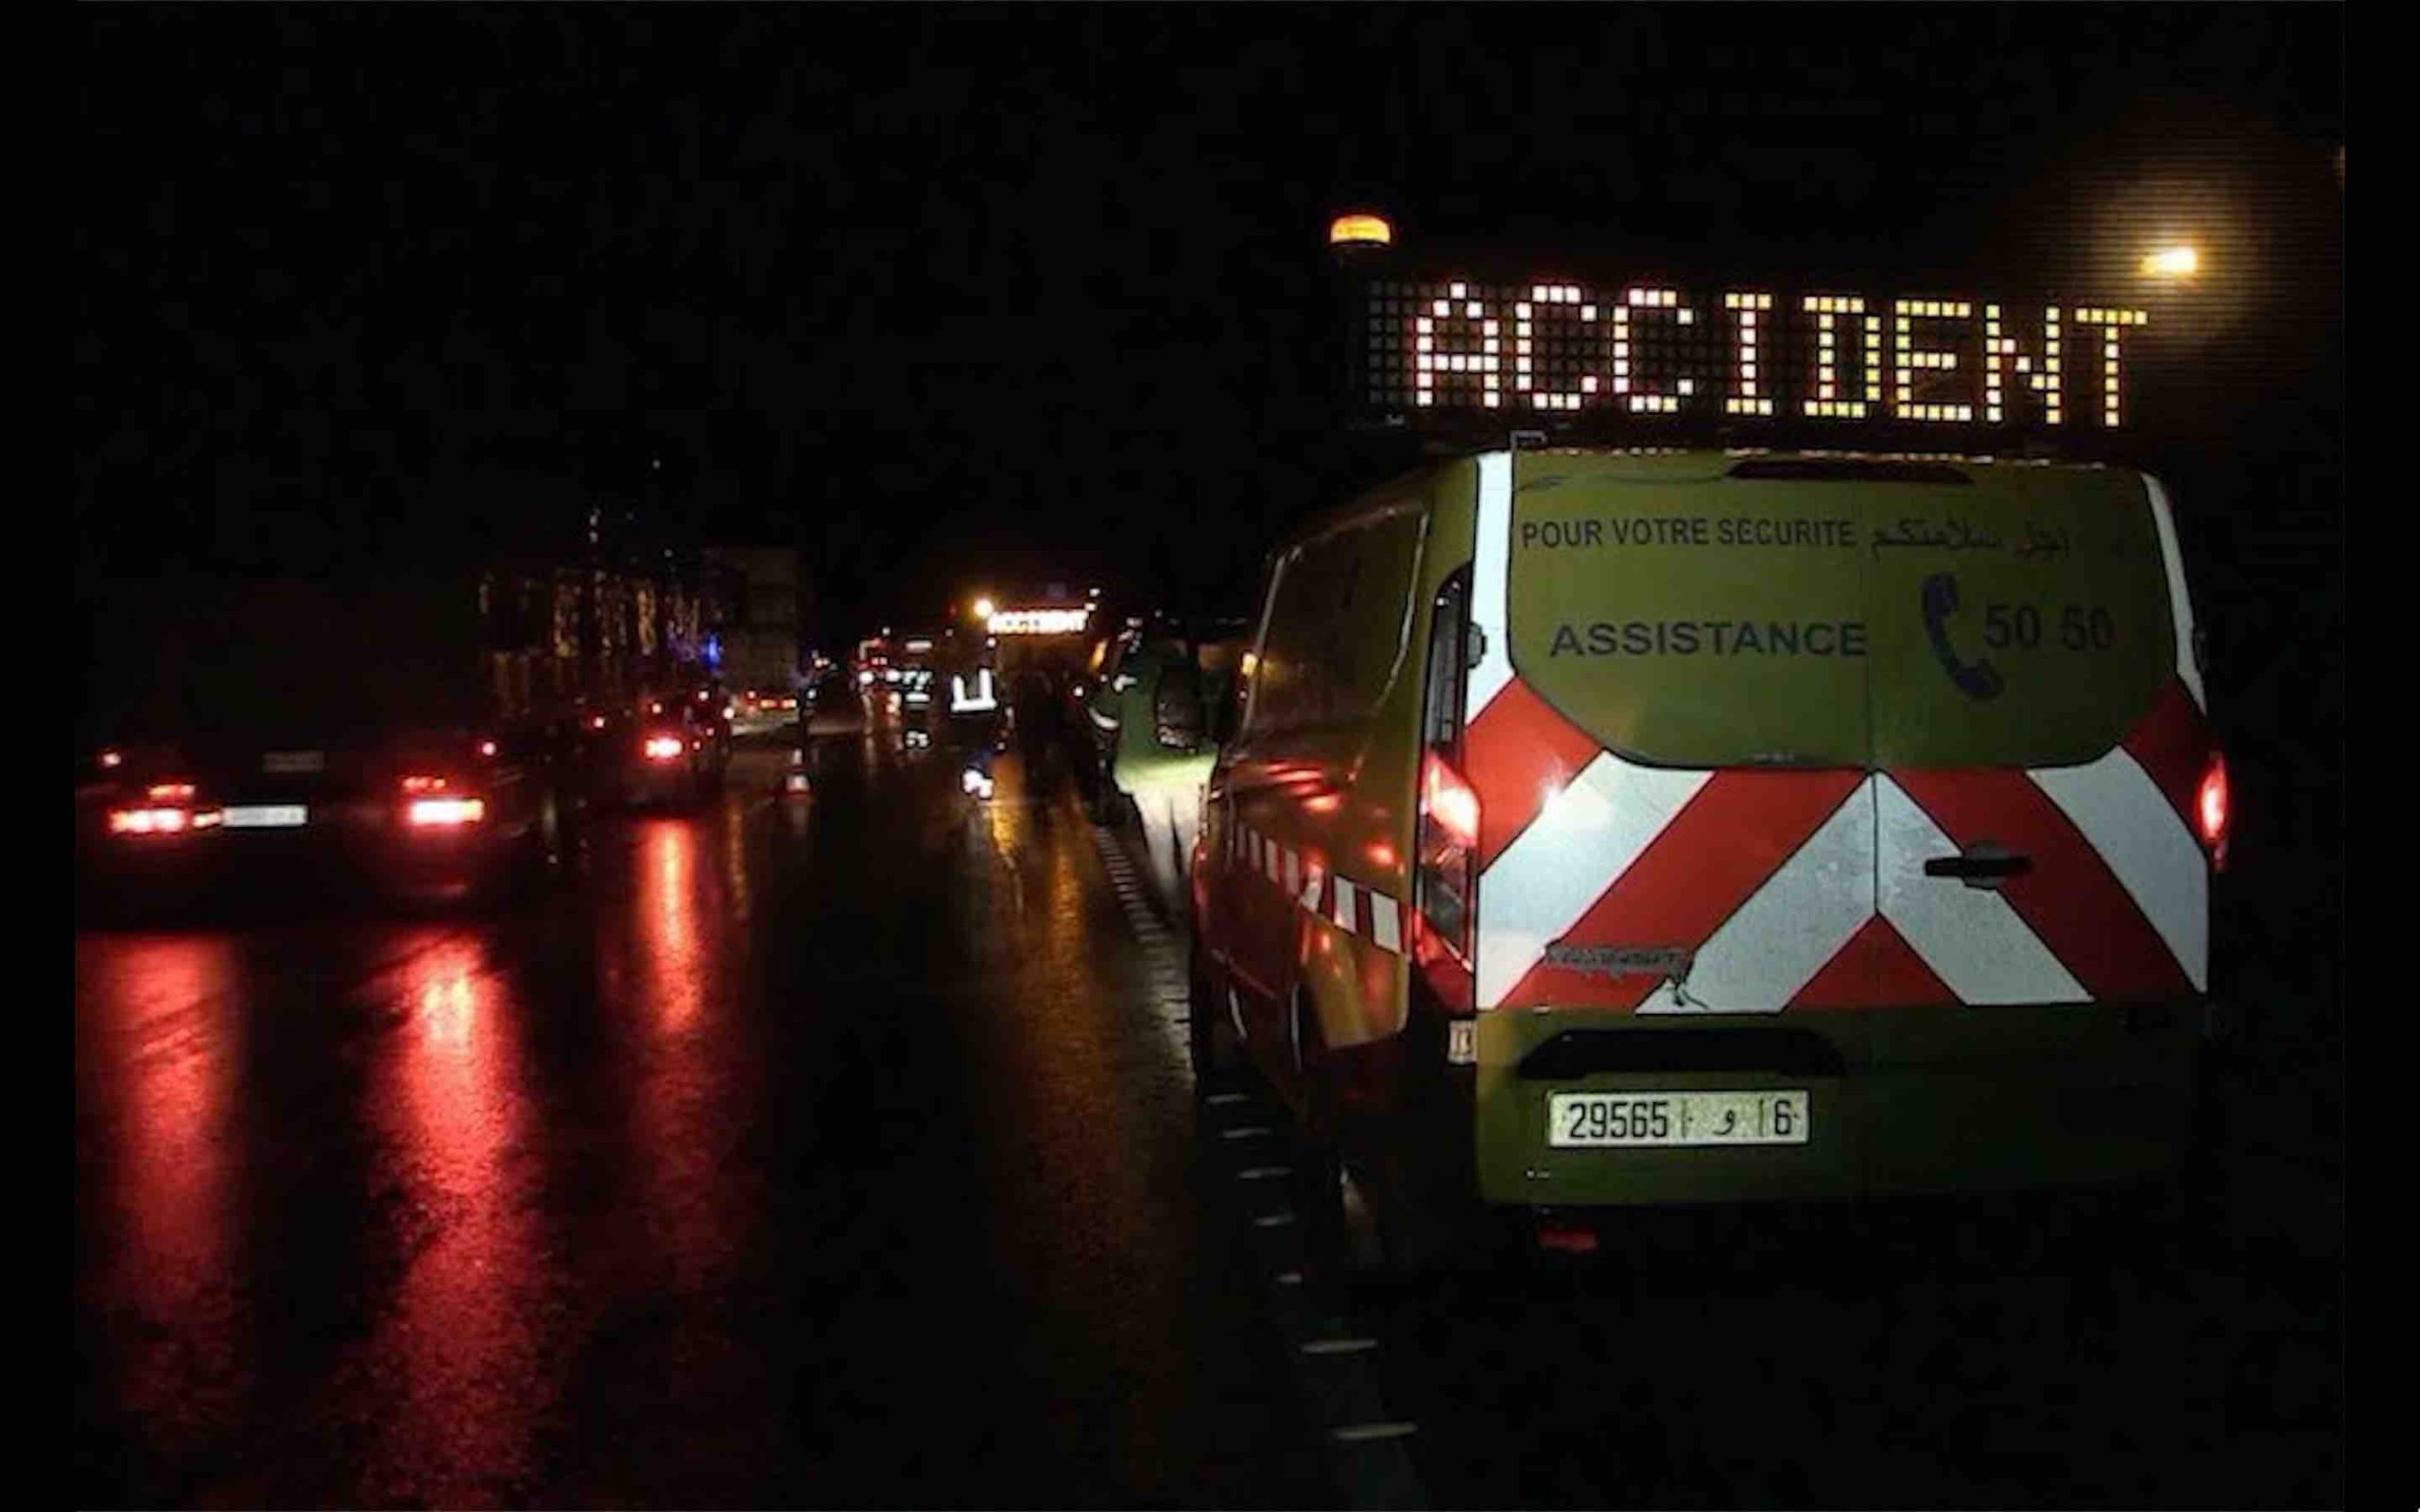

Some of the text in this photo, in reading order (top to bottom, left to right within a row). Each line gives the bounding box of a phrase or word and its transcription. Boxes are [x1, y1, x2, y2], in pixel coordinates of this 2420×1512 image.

[1415, 281, 2149, 428] ACCIDENT
[1521, 520, 1603, 549] POUR
[1613, 517, 1711, 546] VOTRE
[1548, 621, 1868, 658] ASSISTANCE
[1984, 604, 2115, 652] 50 50
[1568, 1101, 1669, 1139] 29565
[1772, 1099, 1793, 1136] 6
